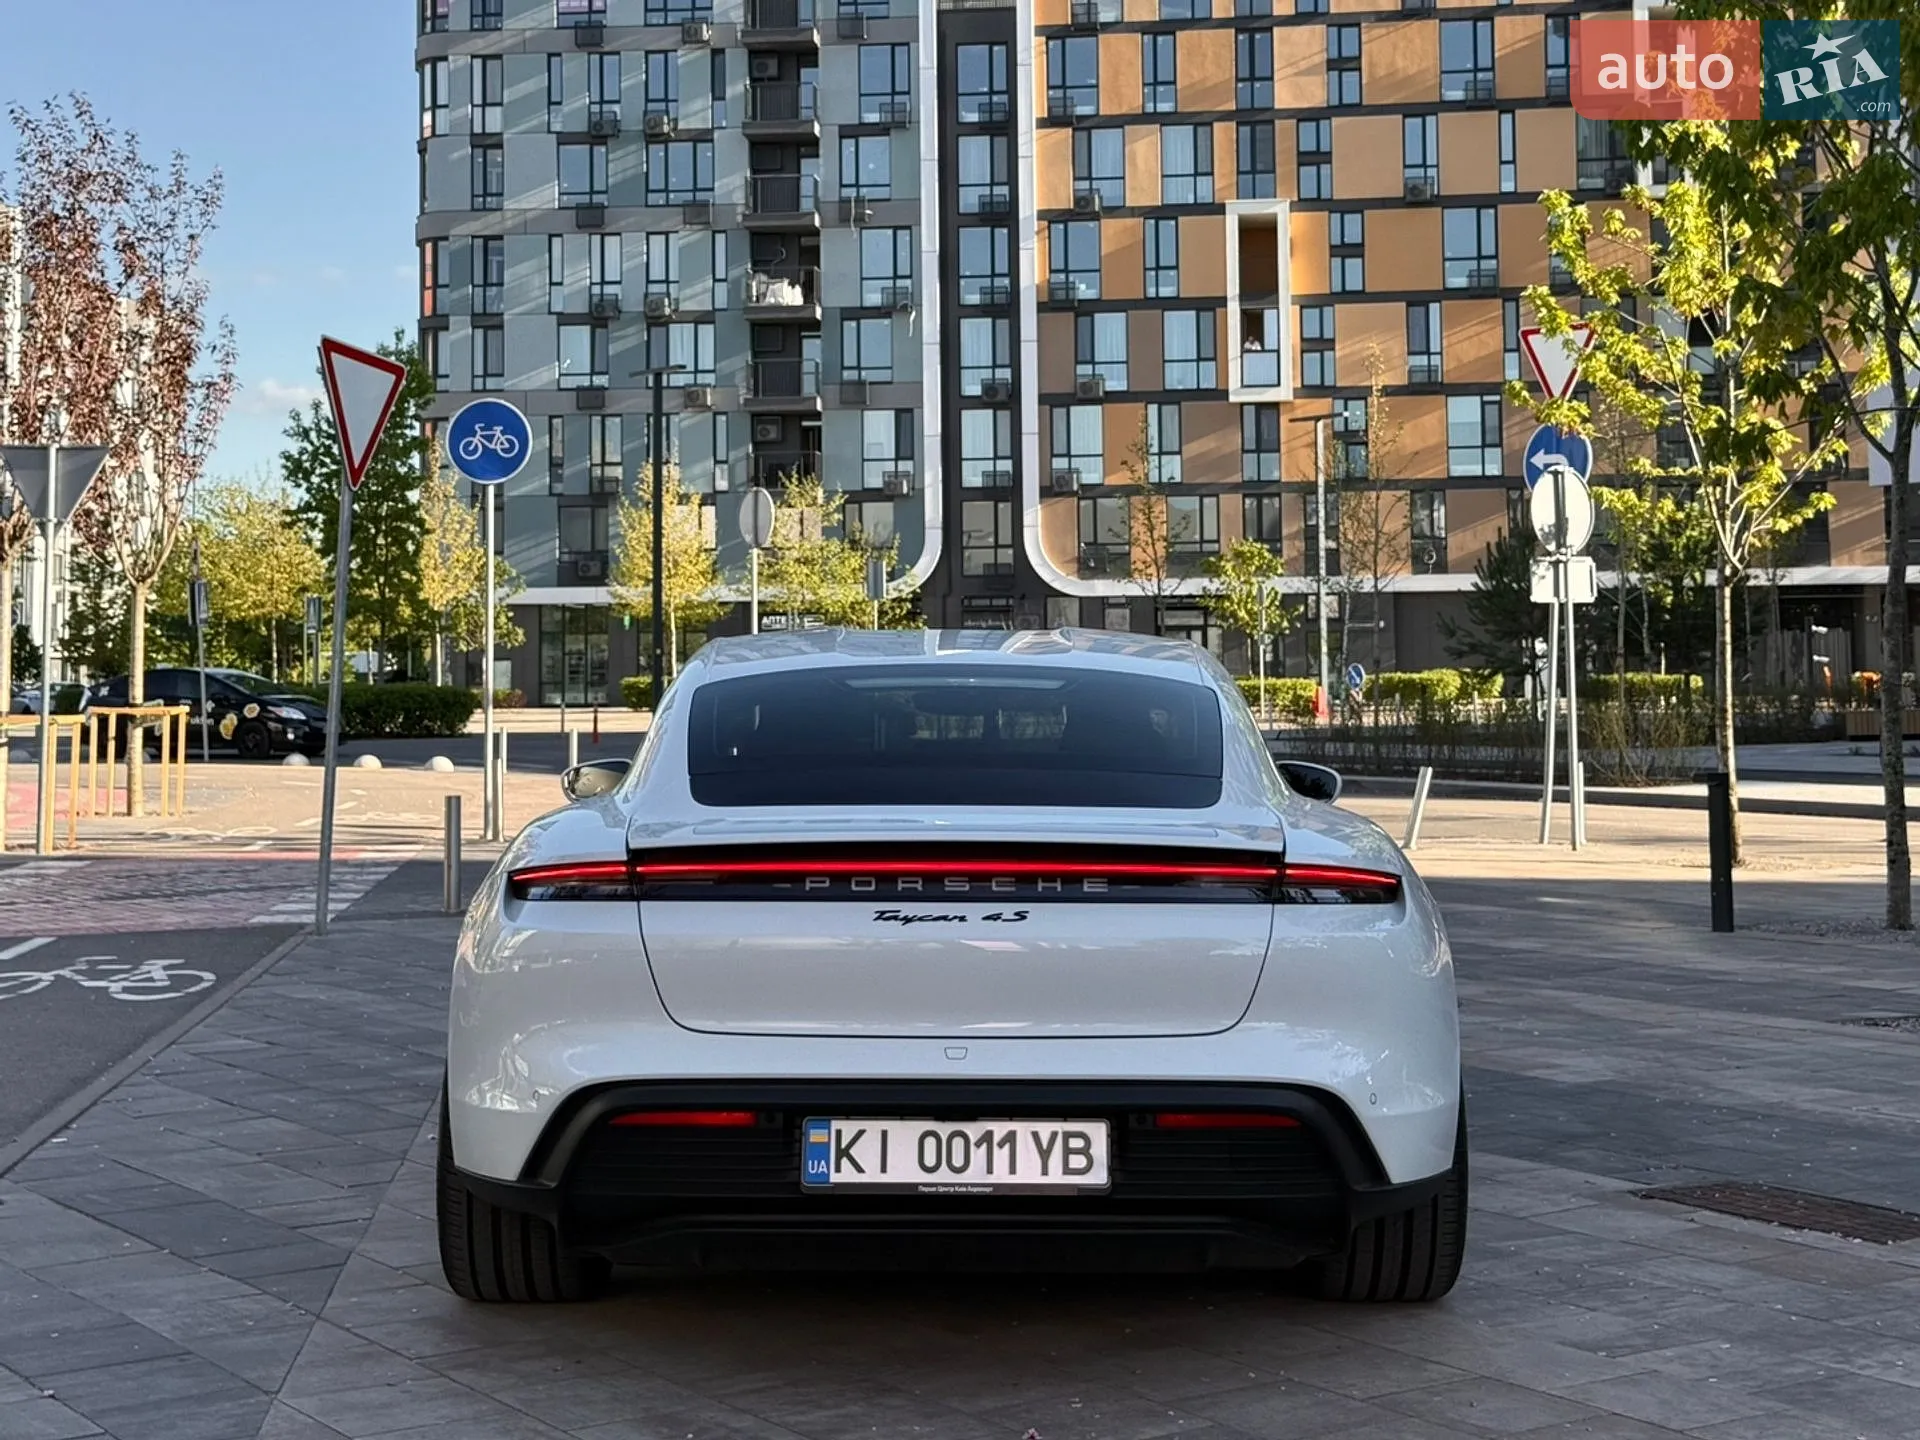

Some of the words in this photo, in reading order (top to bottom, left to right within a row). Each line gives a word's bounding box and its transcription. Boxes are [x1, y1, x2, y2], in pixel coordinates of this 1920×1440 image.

[804, 877, 1109, 892] PORSCHE
[873, 909, 968, 926] Taycan
[981, 910, 1030, 922] 4S
[808, 1159, 828, 1174] UA
